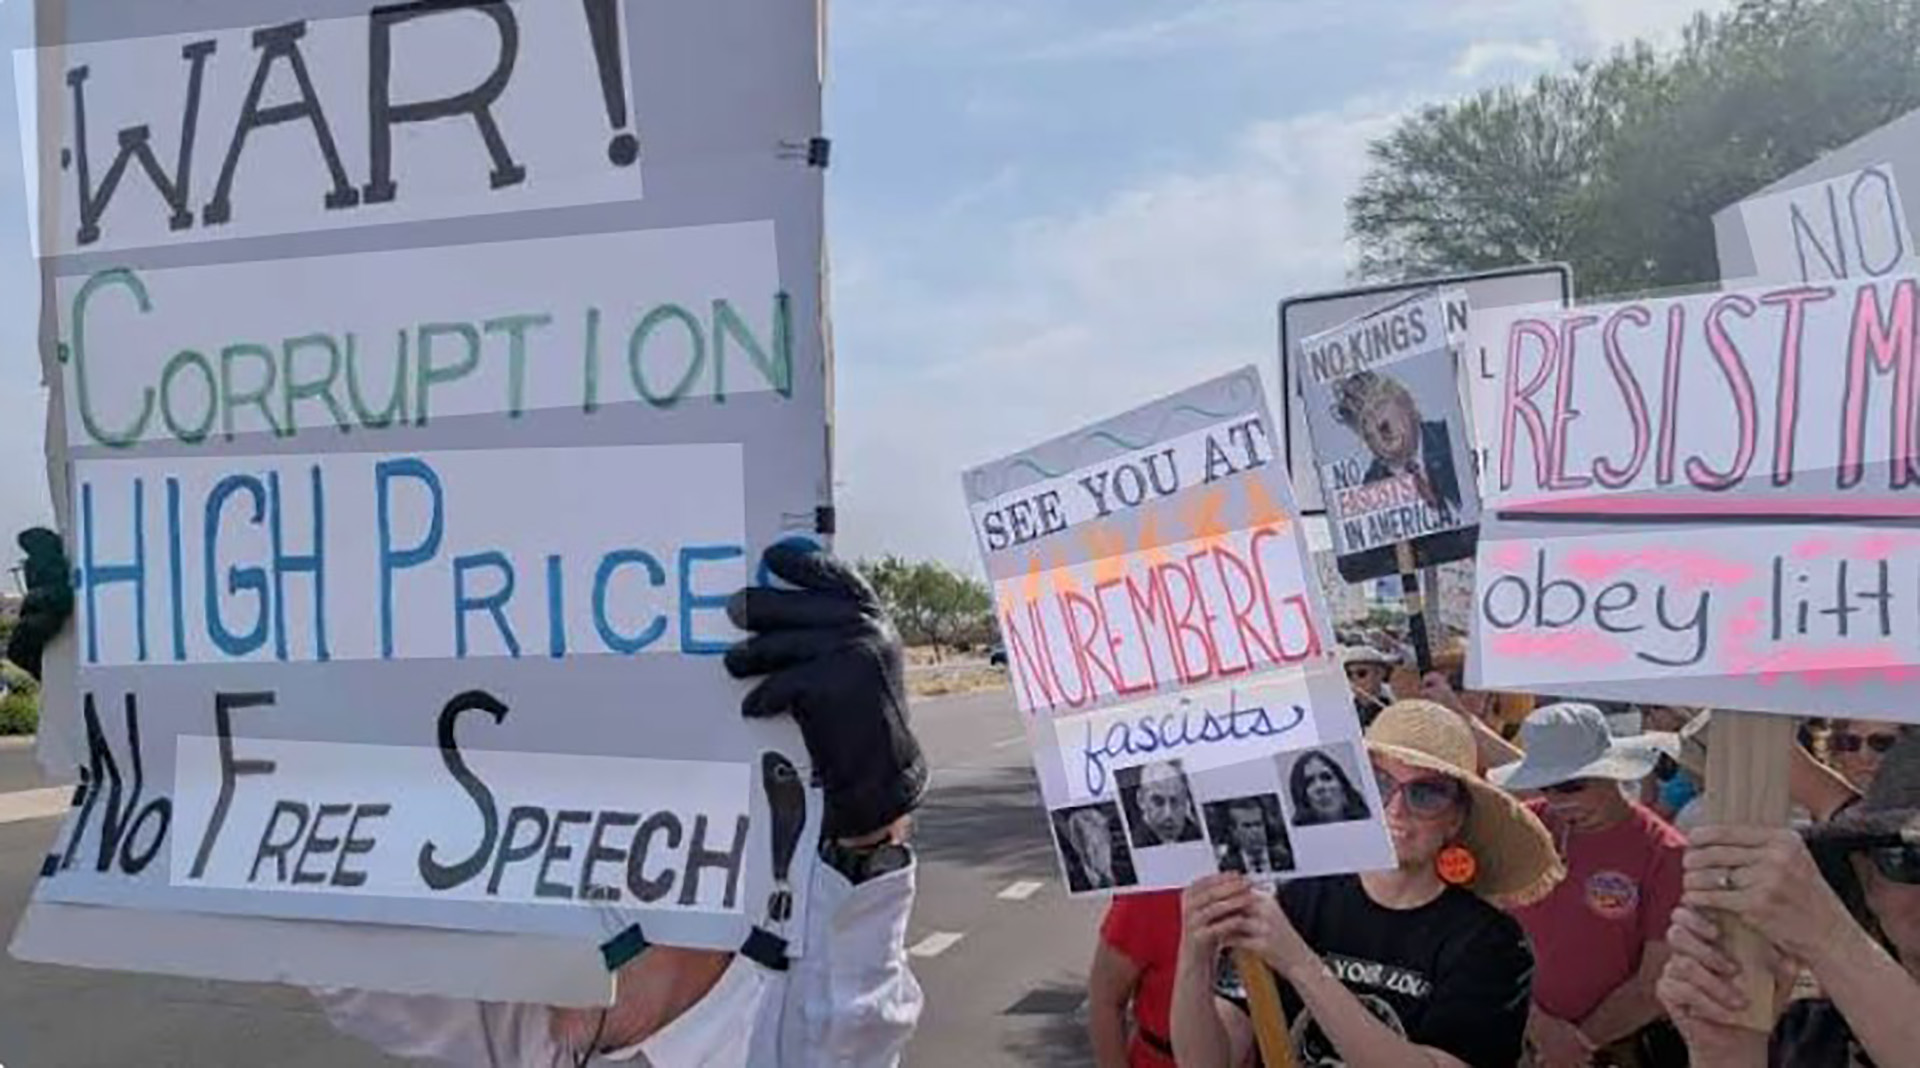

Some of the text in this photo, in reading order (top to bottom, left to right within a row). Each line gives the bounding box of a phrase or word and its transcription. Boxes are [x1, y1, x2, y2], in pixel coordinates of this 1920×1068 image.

[1791, 167, 1904, 281] NO
[71, 267, 793, 447] CORRUPTION
[1310, 341, 1346, 382] NO
[1347, 306, 1428, 373] KINGS
[1501, 279, 1920, 491] RESIST M
[983, 418, 1267, 551] SEE YOU AT
[1332, 457, 1362, 490] NO
[1344, 518, 1366, 550] IN
[82, 457, 823, 663] HIGH PRICE
[1005, 527, 1323, 716] NUREMBERG
[1483, 547, 1920, 666] obey litt
[190, 691, 391, 887] FREE
[1084, 689, 1305, 796] fascists
